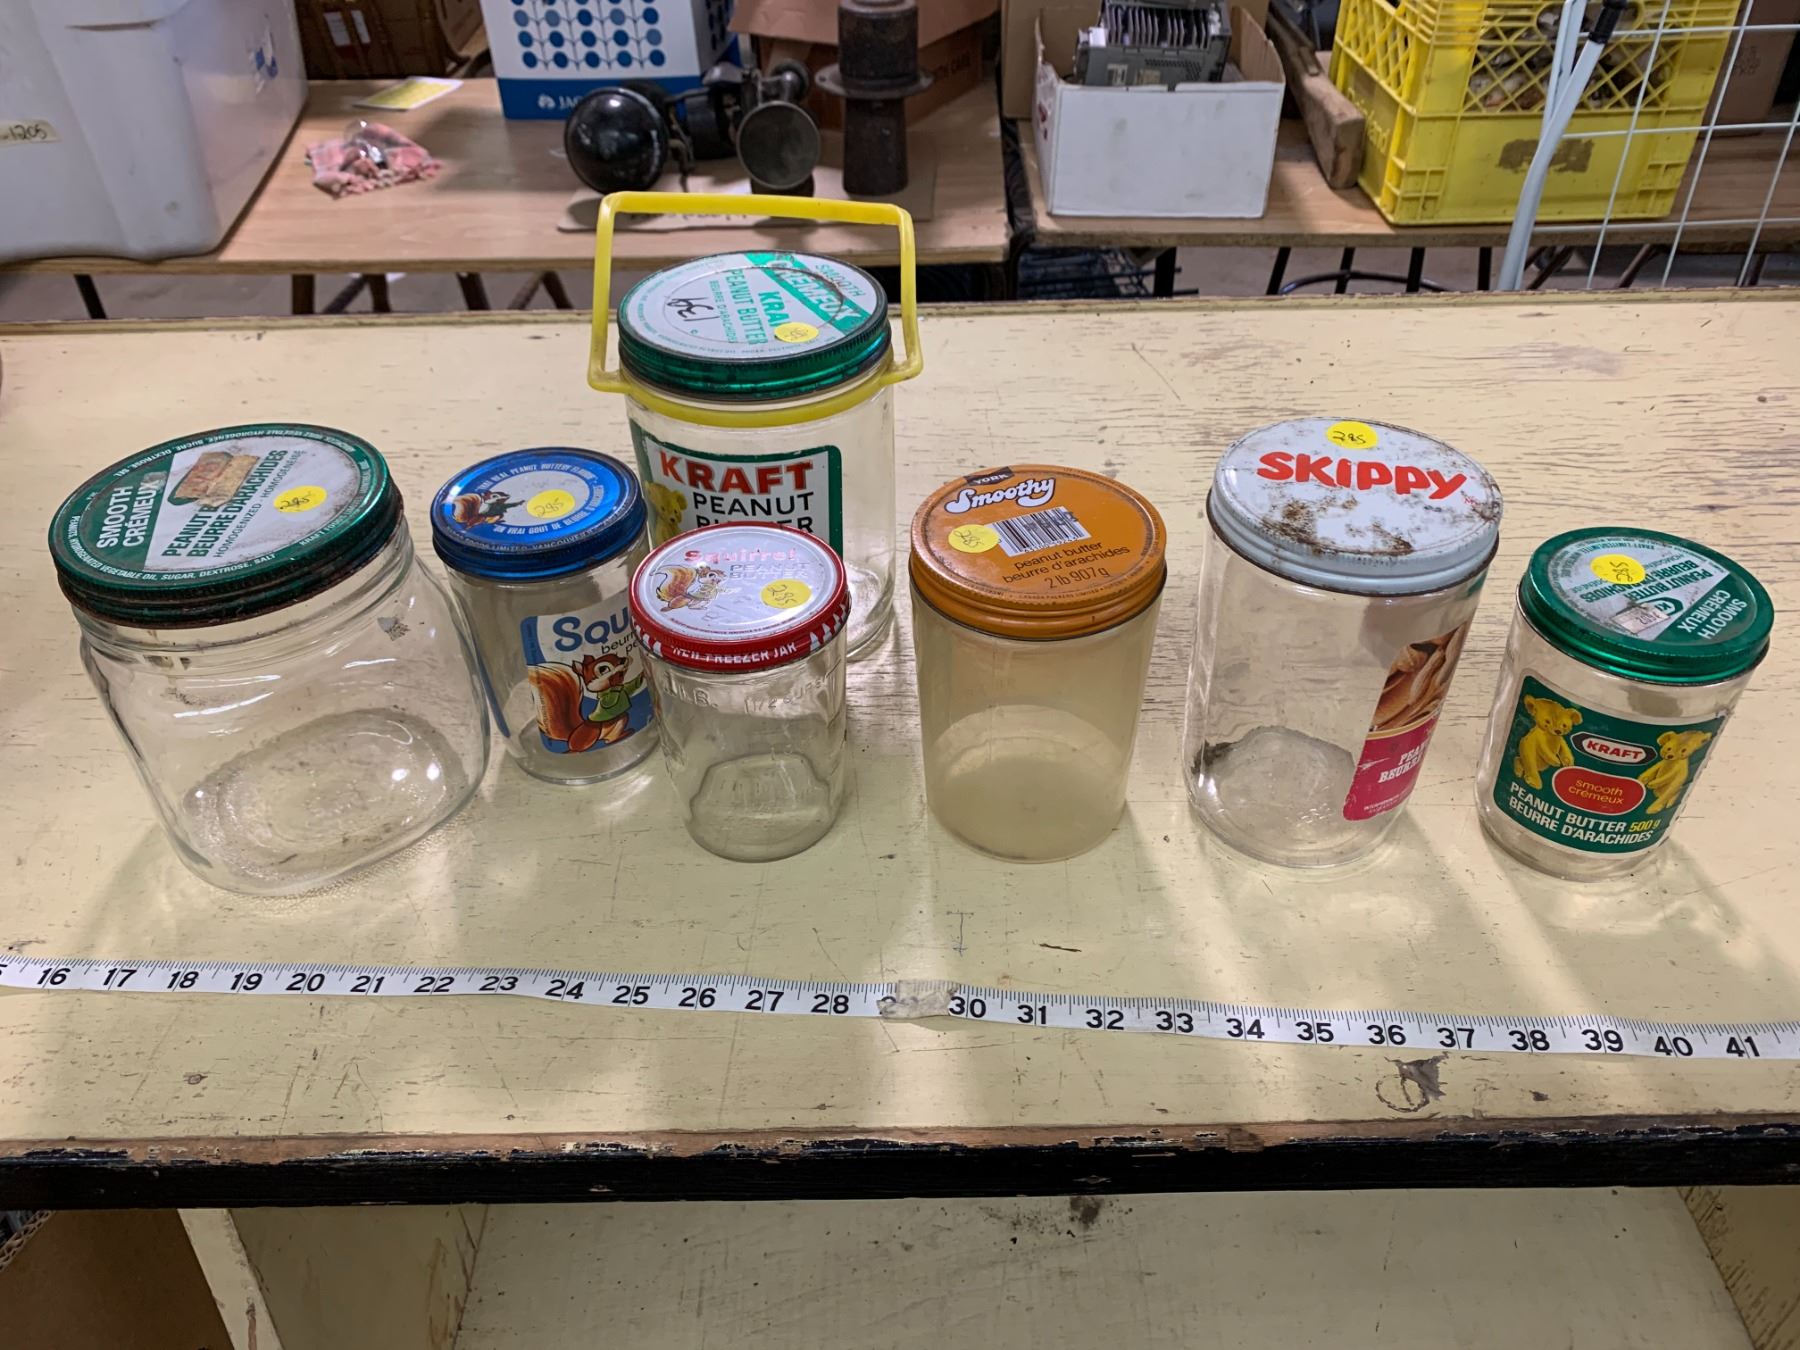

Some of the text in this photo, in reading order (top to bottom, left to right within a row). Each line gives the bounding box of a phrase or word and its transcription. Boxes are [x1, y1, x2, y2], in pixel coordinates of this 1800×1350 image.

[737, 307, 768, 345] BUTTER
[659, 449, 815, 497] KRAFT
[975, 473, 1010, 485] YORK
[122, 479, 160, 547] CRÉMEUX
[691, 491, 815, 517] PEANUT
[944, 477, 1056, 514] Smoothy
[96, 485, 134, 549] SMOOTH
[161, 512, 212, 556] PEANUT
[187, 514, 237, 557] BEURRE
[213, 503, 263, 558] HOMOGENIZED
[101, 563, 142, 580] VEGETABLE
[254, 555, 276, 565] SALT
[684, 547, 798, 565] Squirrel
[1002, 565, 1050, 584] beurre
[1051, 545, 1131, 572] d'arachides
[1013, 552, 1063, 571] peanut
[1062, 541, 1104, 559] butter
[1650, 559, 1699, 579] BEURRE
[1044, 577, 1057, 590] 2
[1069, 566, 1097, 581] 907
[1097, 567, 1111, 578] g
[1623, 579, 1669, 602] BUTTER
[1664, 568, 1714, 590] PEANUT
[1697, 598, 1748, 640] SMOOTH
[773, 642, 798, 659] JAR
[1586, 740, 1643, 760] KRAFT
[1575, 779, 1624, 797] smooth
[1508, 796, 1655, 846] BEURRE D'ARACHIDES
[1509, 781, 1566, 820] PEANUT
[1566, 812, 1628, 833] BUTTER
[1628, 820, 1652, 832] 500
[37, 968, 1760, 1057] 16 17 18 19 20 21 22 23 24 25 26 27 28 30 31 32 33 34 35 36 37 38 39 40 41
